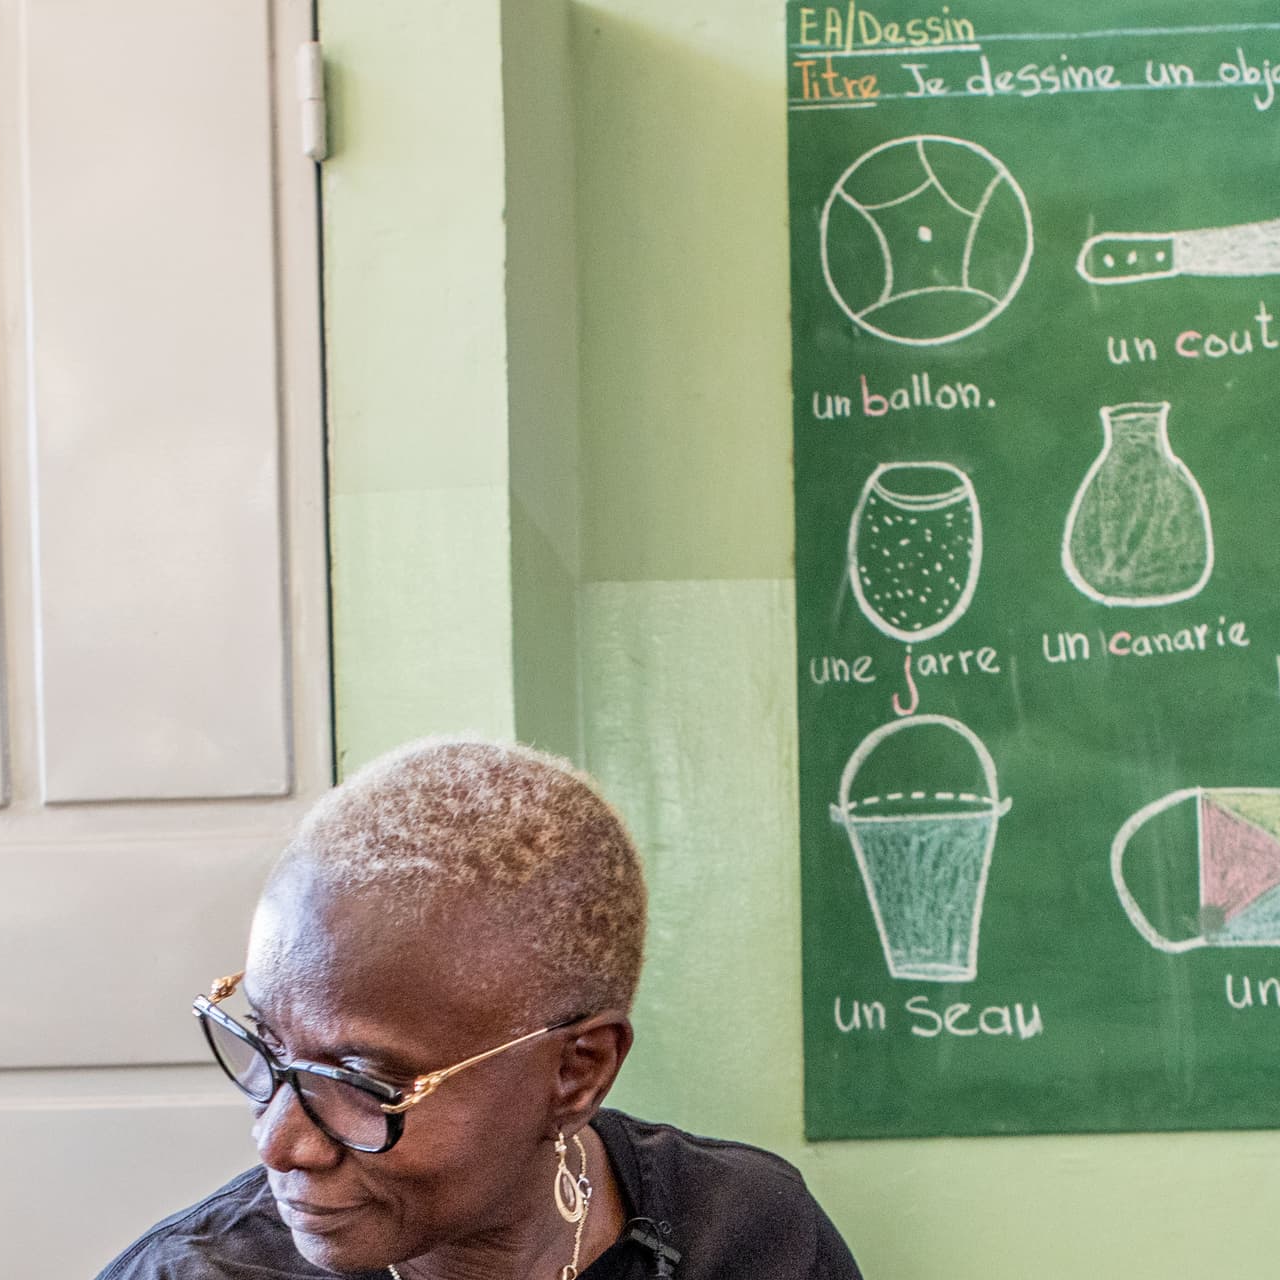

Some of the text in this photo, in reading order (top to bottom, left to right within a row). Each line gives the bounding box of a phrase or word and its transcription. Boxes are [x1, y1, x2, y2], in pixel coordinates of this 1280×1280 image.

[793, 58, 880, 100] Titre
[900, 63, 951, 97] Je
[966, 55, 1122, 97] dessine
[1145, 60, 1194, 86] un
[1108, 333, 1157, 364] un
[812, 373, 996, 419] un ballon.
[1042, 616, 1251, 663] un canarie
[809, 645, 1001, 716] une jarre
[834, 995, 887, 1033] un
